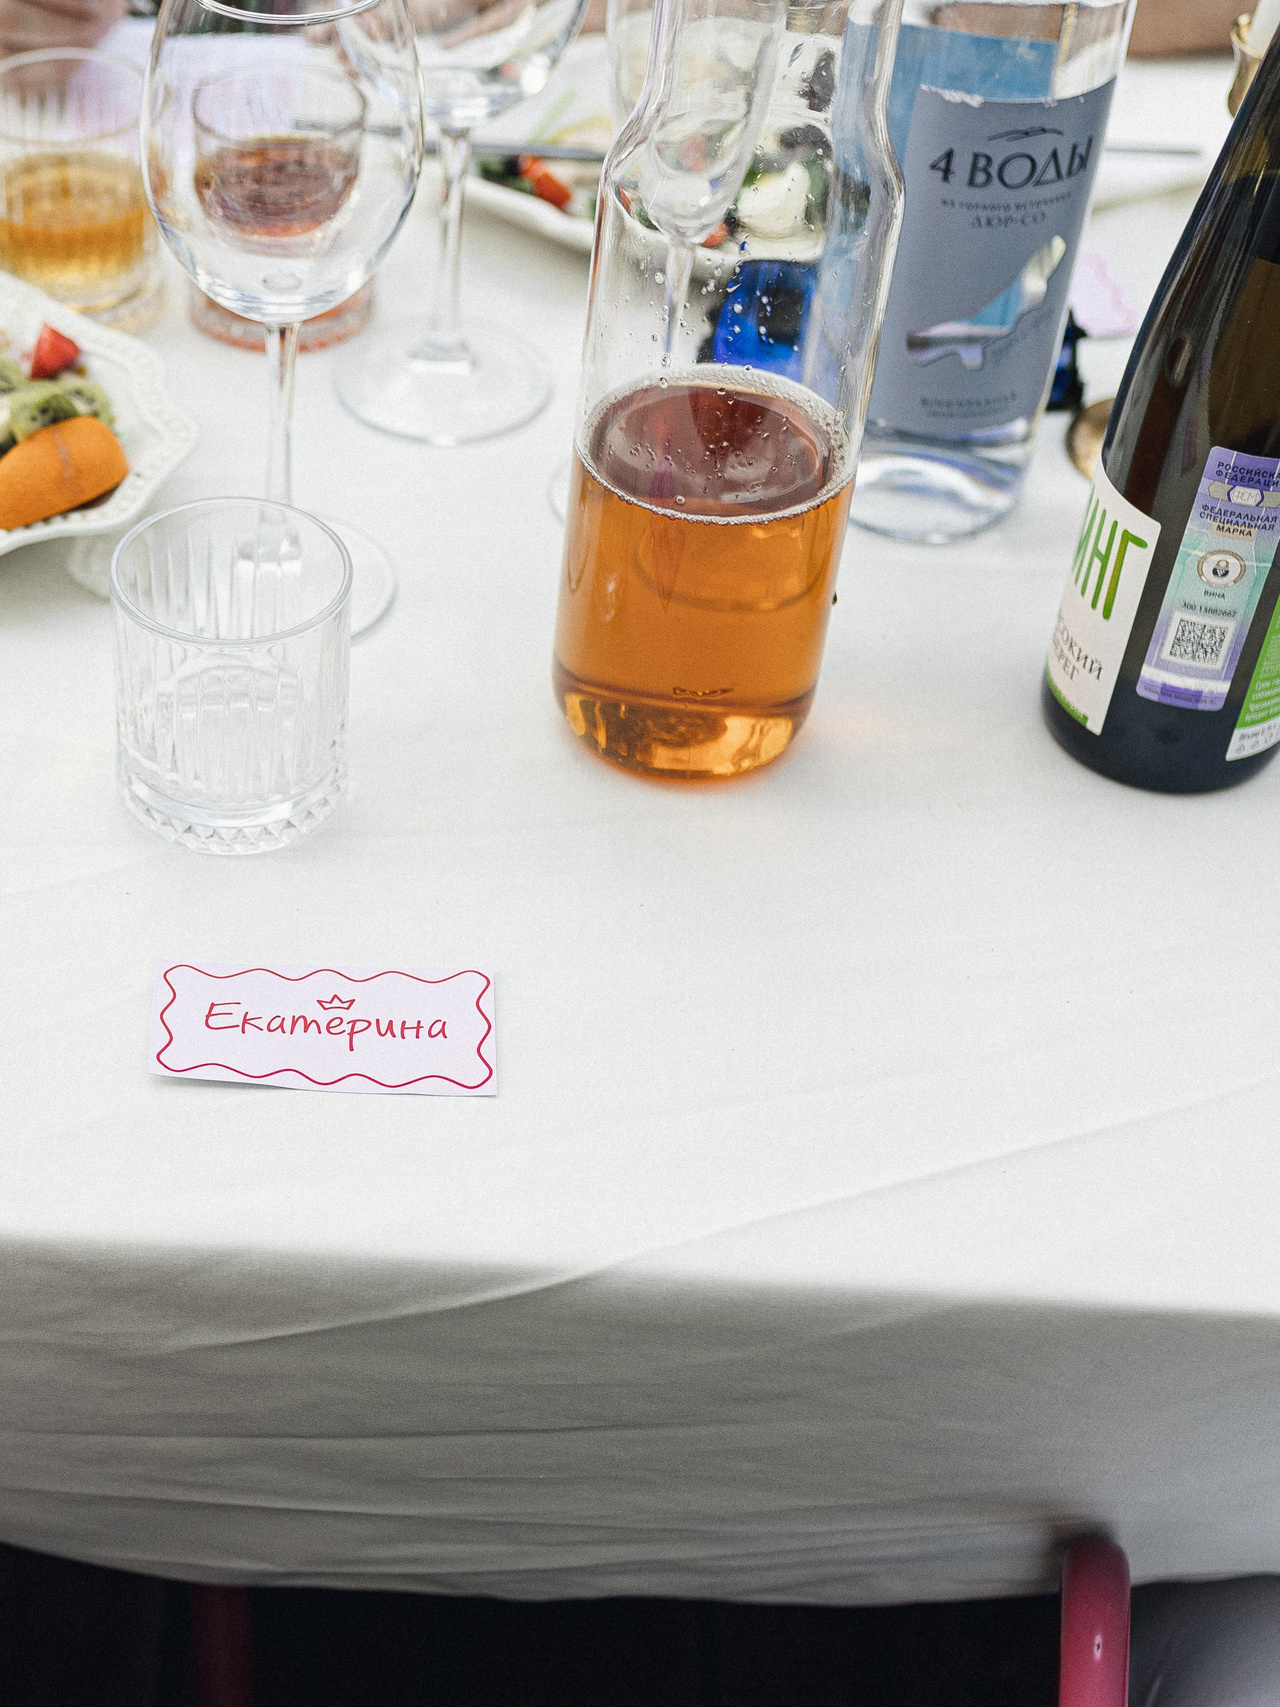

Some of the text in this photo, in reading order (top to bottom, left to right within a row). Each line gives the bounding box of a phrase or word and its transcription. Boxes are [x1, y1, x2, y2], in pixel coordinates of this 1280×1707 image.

[929, 134, 1094, 190] 4 ВОДЫ
[1199, 511, 1275, 531] СПЕЦИАЛЬНАЯ
[1201, 504, 1278, 523] ФЕДЕРАЛЬНАЯ
[1216, 524, 1253, 538] МАРКА
[204, 1001, 448, 1052] Екатерина
